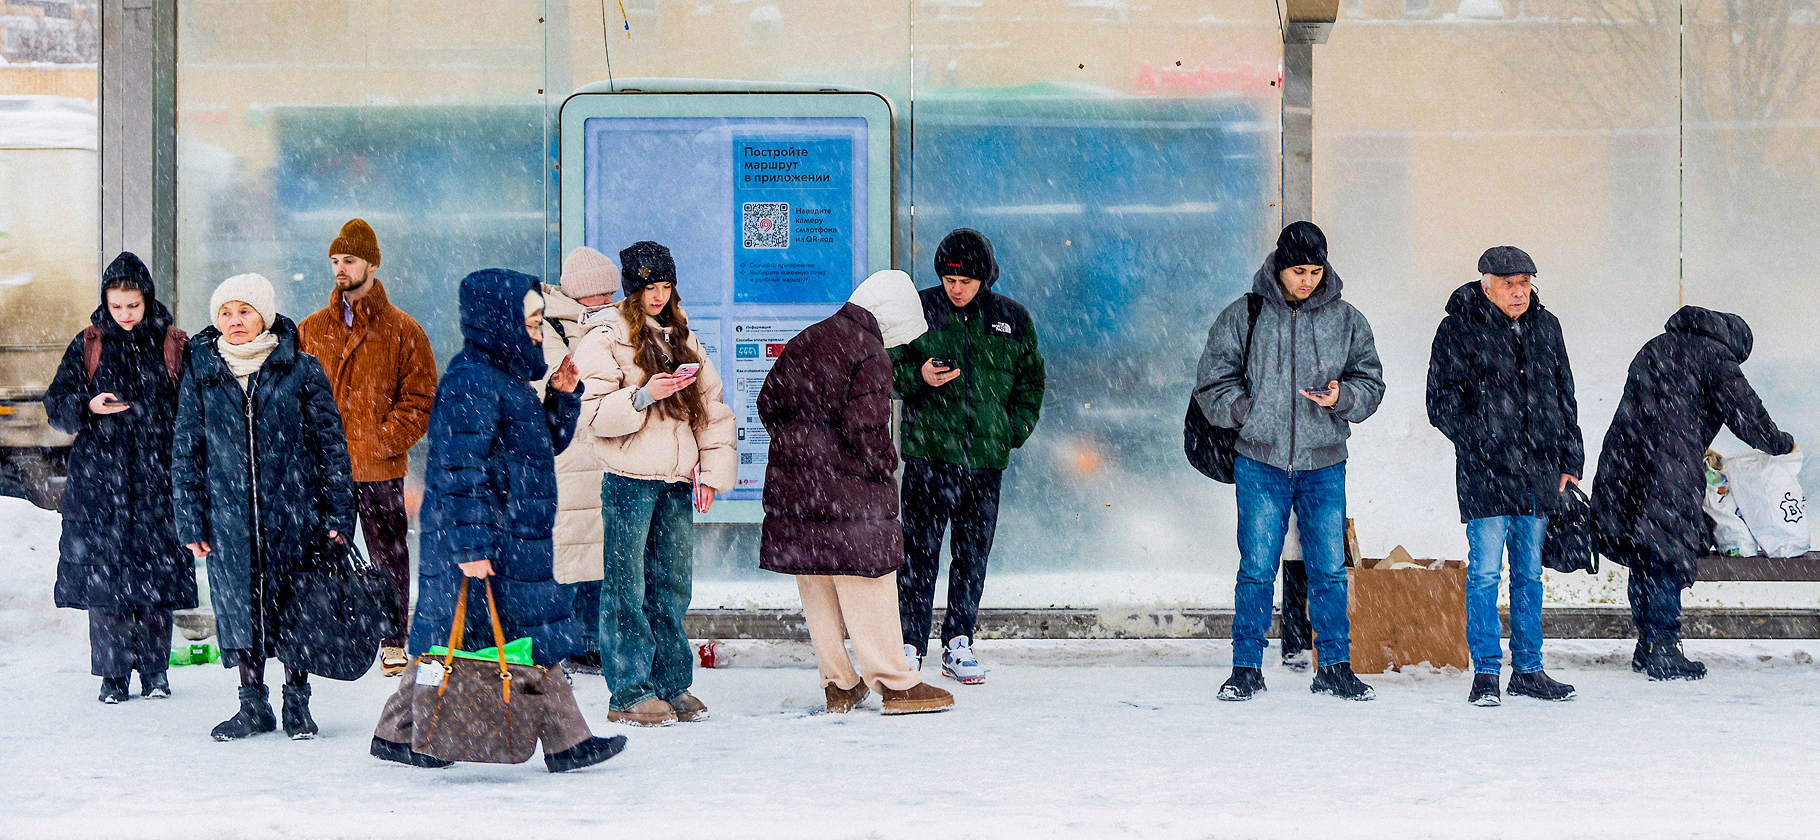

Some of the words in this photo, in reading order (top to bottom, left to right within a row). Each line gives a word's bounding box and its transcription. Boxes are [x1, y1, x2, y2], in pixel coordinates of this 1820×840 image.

[744, 146, 808, 159] Постройте
[744, 161, 798, 171] маршрут
[744, 174, 751, 182] в
[754, 174, 830, 184] приложении
[795, 207, 832, 215] Наведите
[795, 226, 837, 234] смартфона
[805, 235, 834, 243] QR-код
